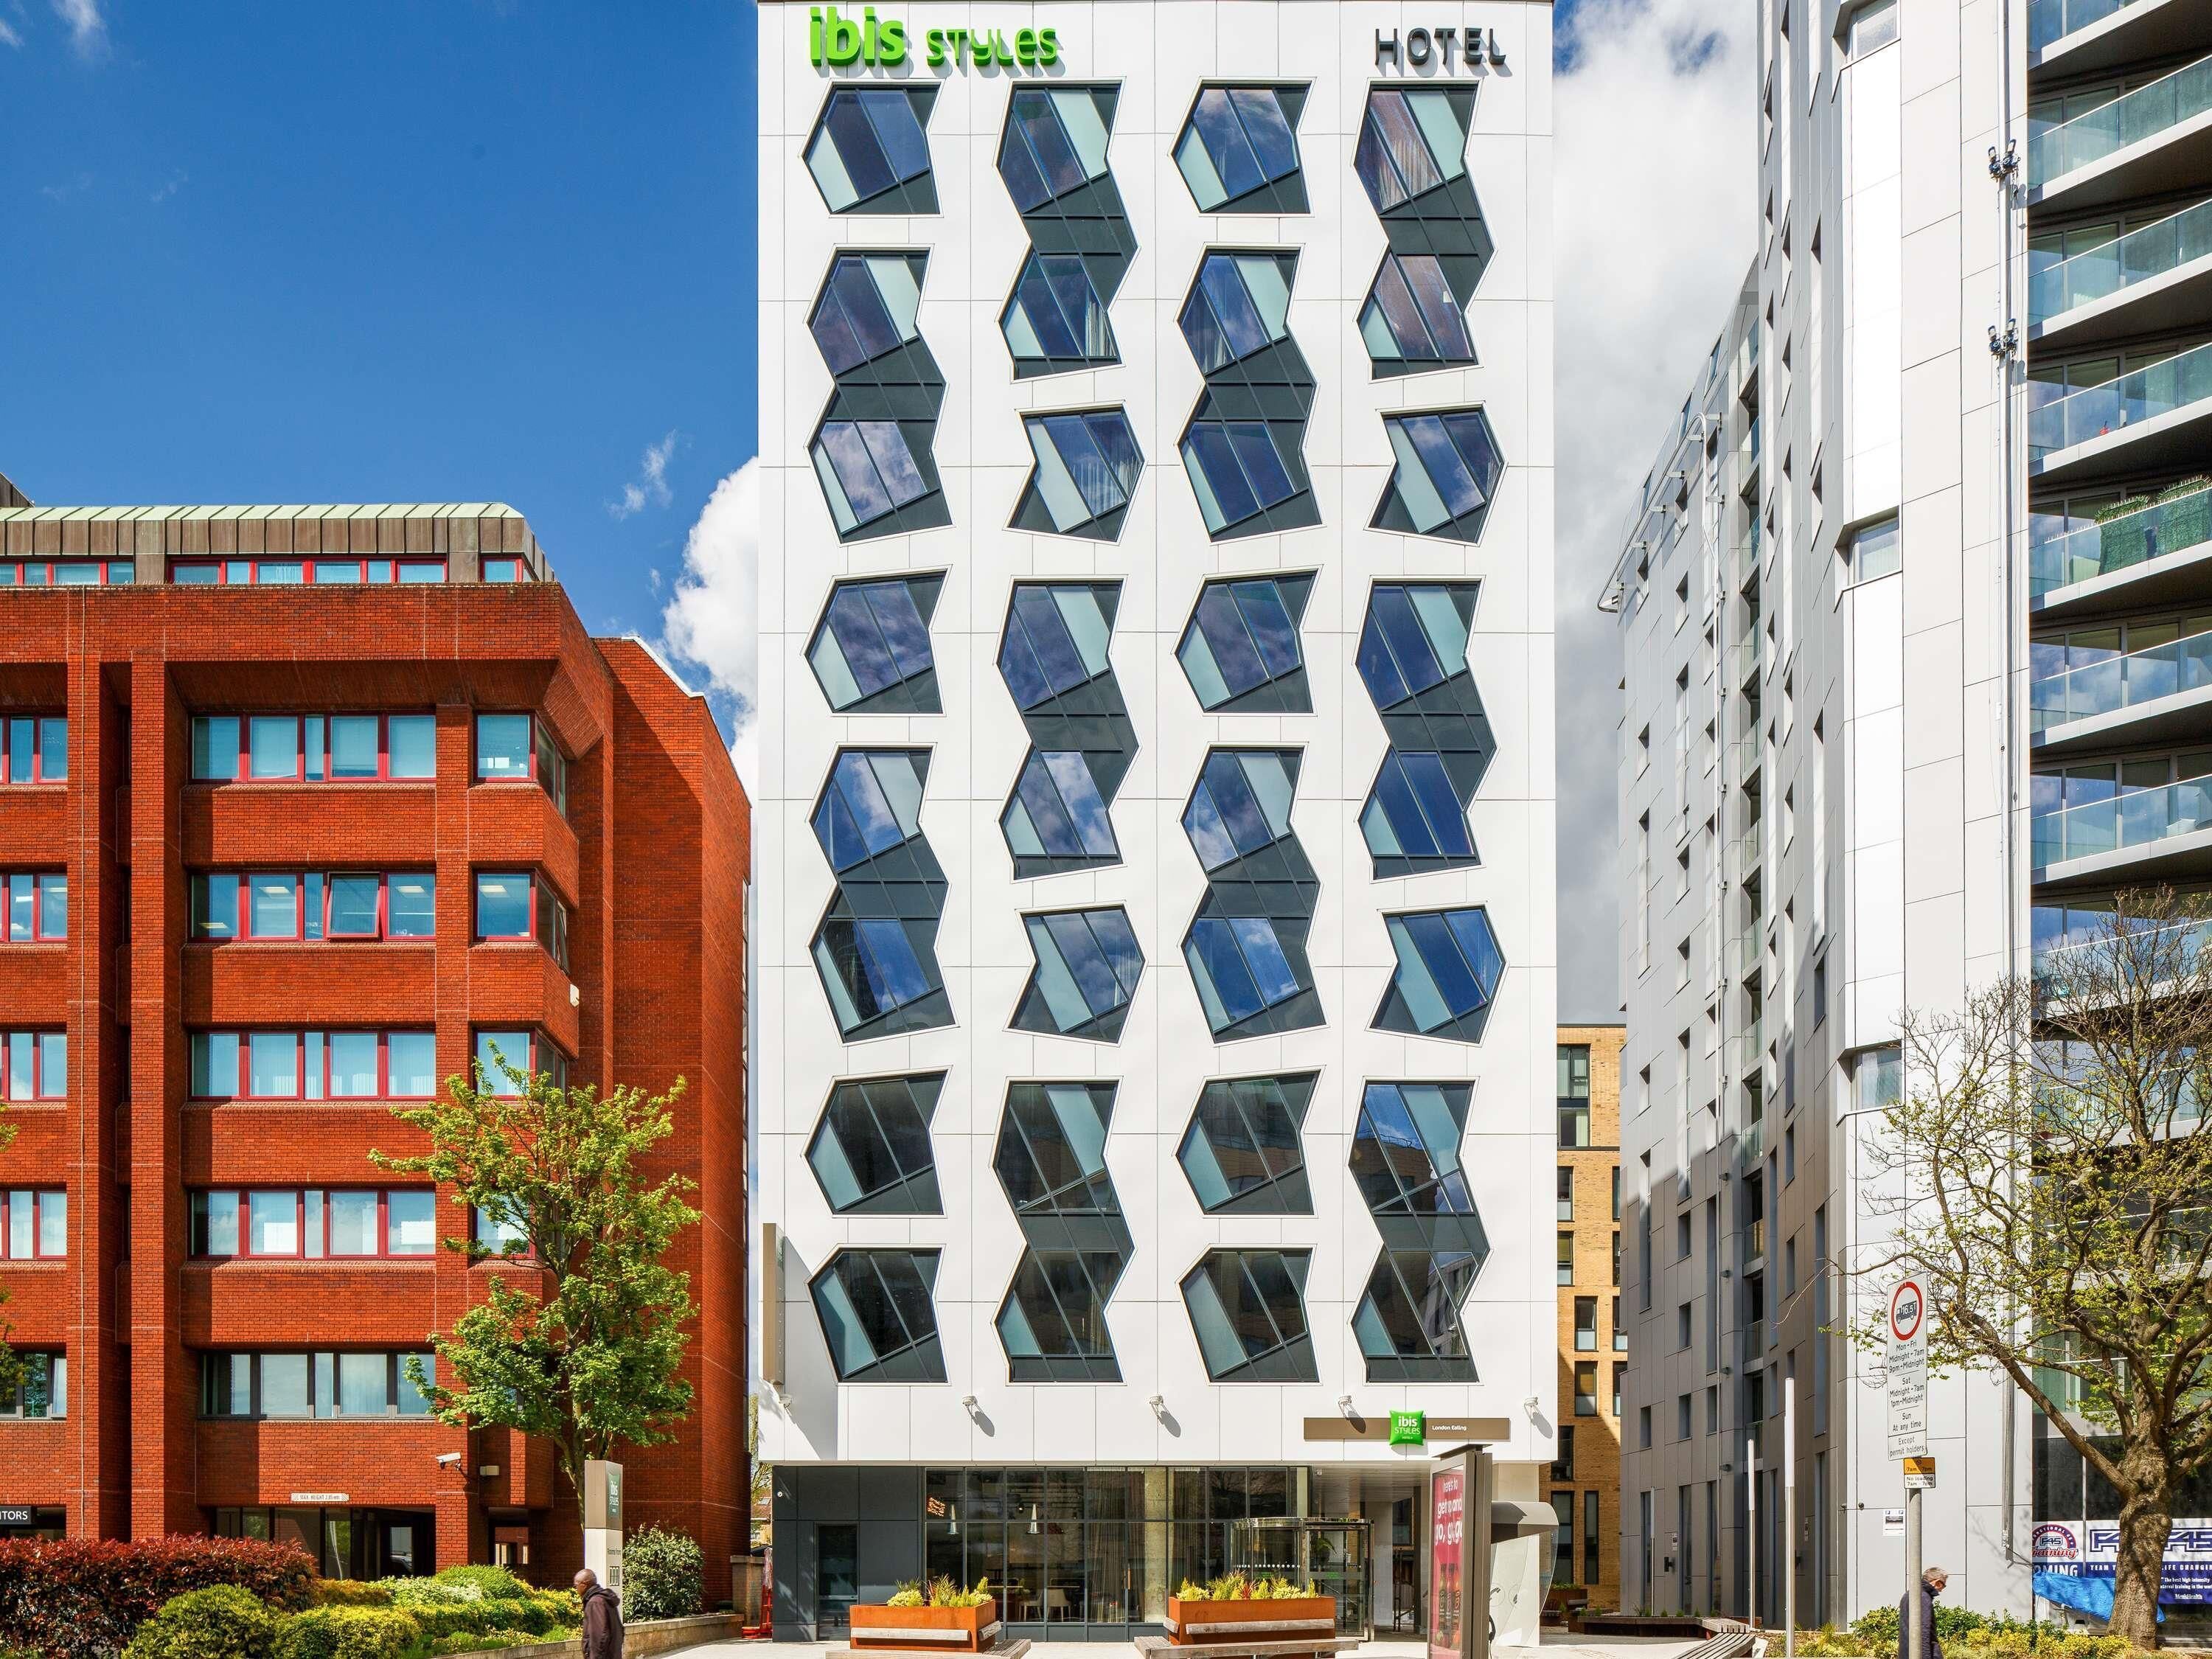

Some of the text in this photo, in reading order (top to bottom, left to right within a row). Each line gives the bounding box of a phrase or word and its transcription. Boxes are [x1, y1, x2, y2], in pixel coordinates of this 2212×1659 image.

[810, 7, 904, 66] ibis
[1375, 27, 1506, 65] HOTEL
[1889, 1352, 1910, 1363] Midnight
[1914, 1349, 1924, 1357] 7am
[1902, 1377, 1910, 1385] Sat
[1890, 1387, 1910, 1397] Midnight
[1902, 1412, 1911, 1420] Sun
[1398, 1416, 1418, 1427] ibis
[1900, 1423, 1908, 1431] any
[1899, 1436, 1915, 1445] Except
[1890, 1444, 1924, 1457] permit holders
[2040, 1537, 2062, 1545] F45
